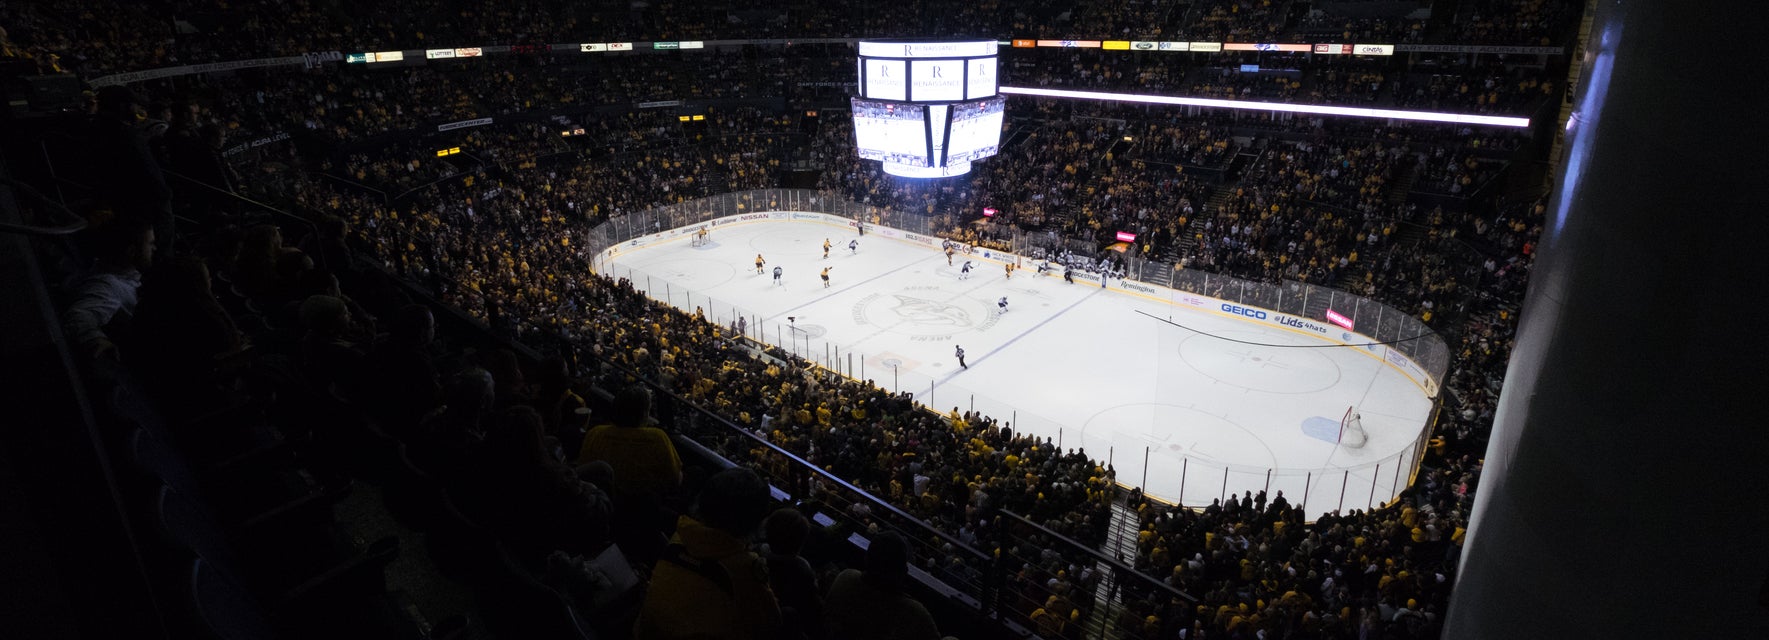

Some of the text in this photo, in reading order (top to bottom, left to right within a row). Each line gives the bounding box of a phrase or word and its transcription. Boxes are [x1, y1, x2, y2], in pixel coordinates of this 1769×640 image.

[904, 44, 913, 56] R
[881, 65, 889, 77] R
[932, 66, 942, 78] R
[979, 63, 985, 76] R
[740, 213, 769, 221] NISSAN
[1120, 280, 1156, 295] Remington
[1221, 303, 1267, 320] GEICO
[1304, 321, 1328, 333] 4hats
